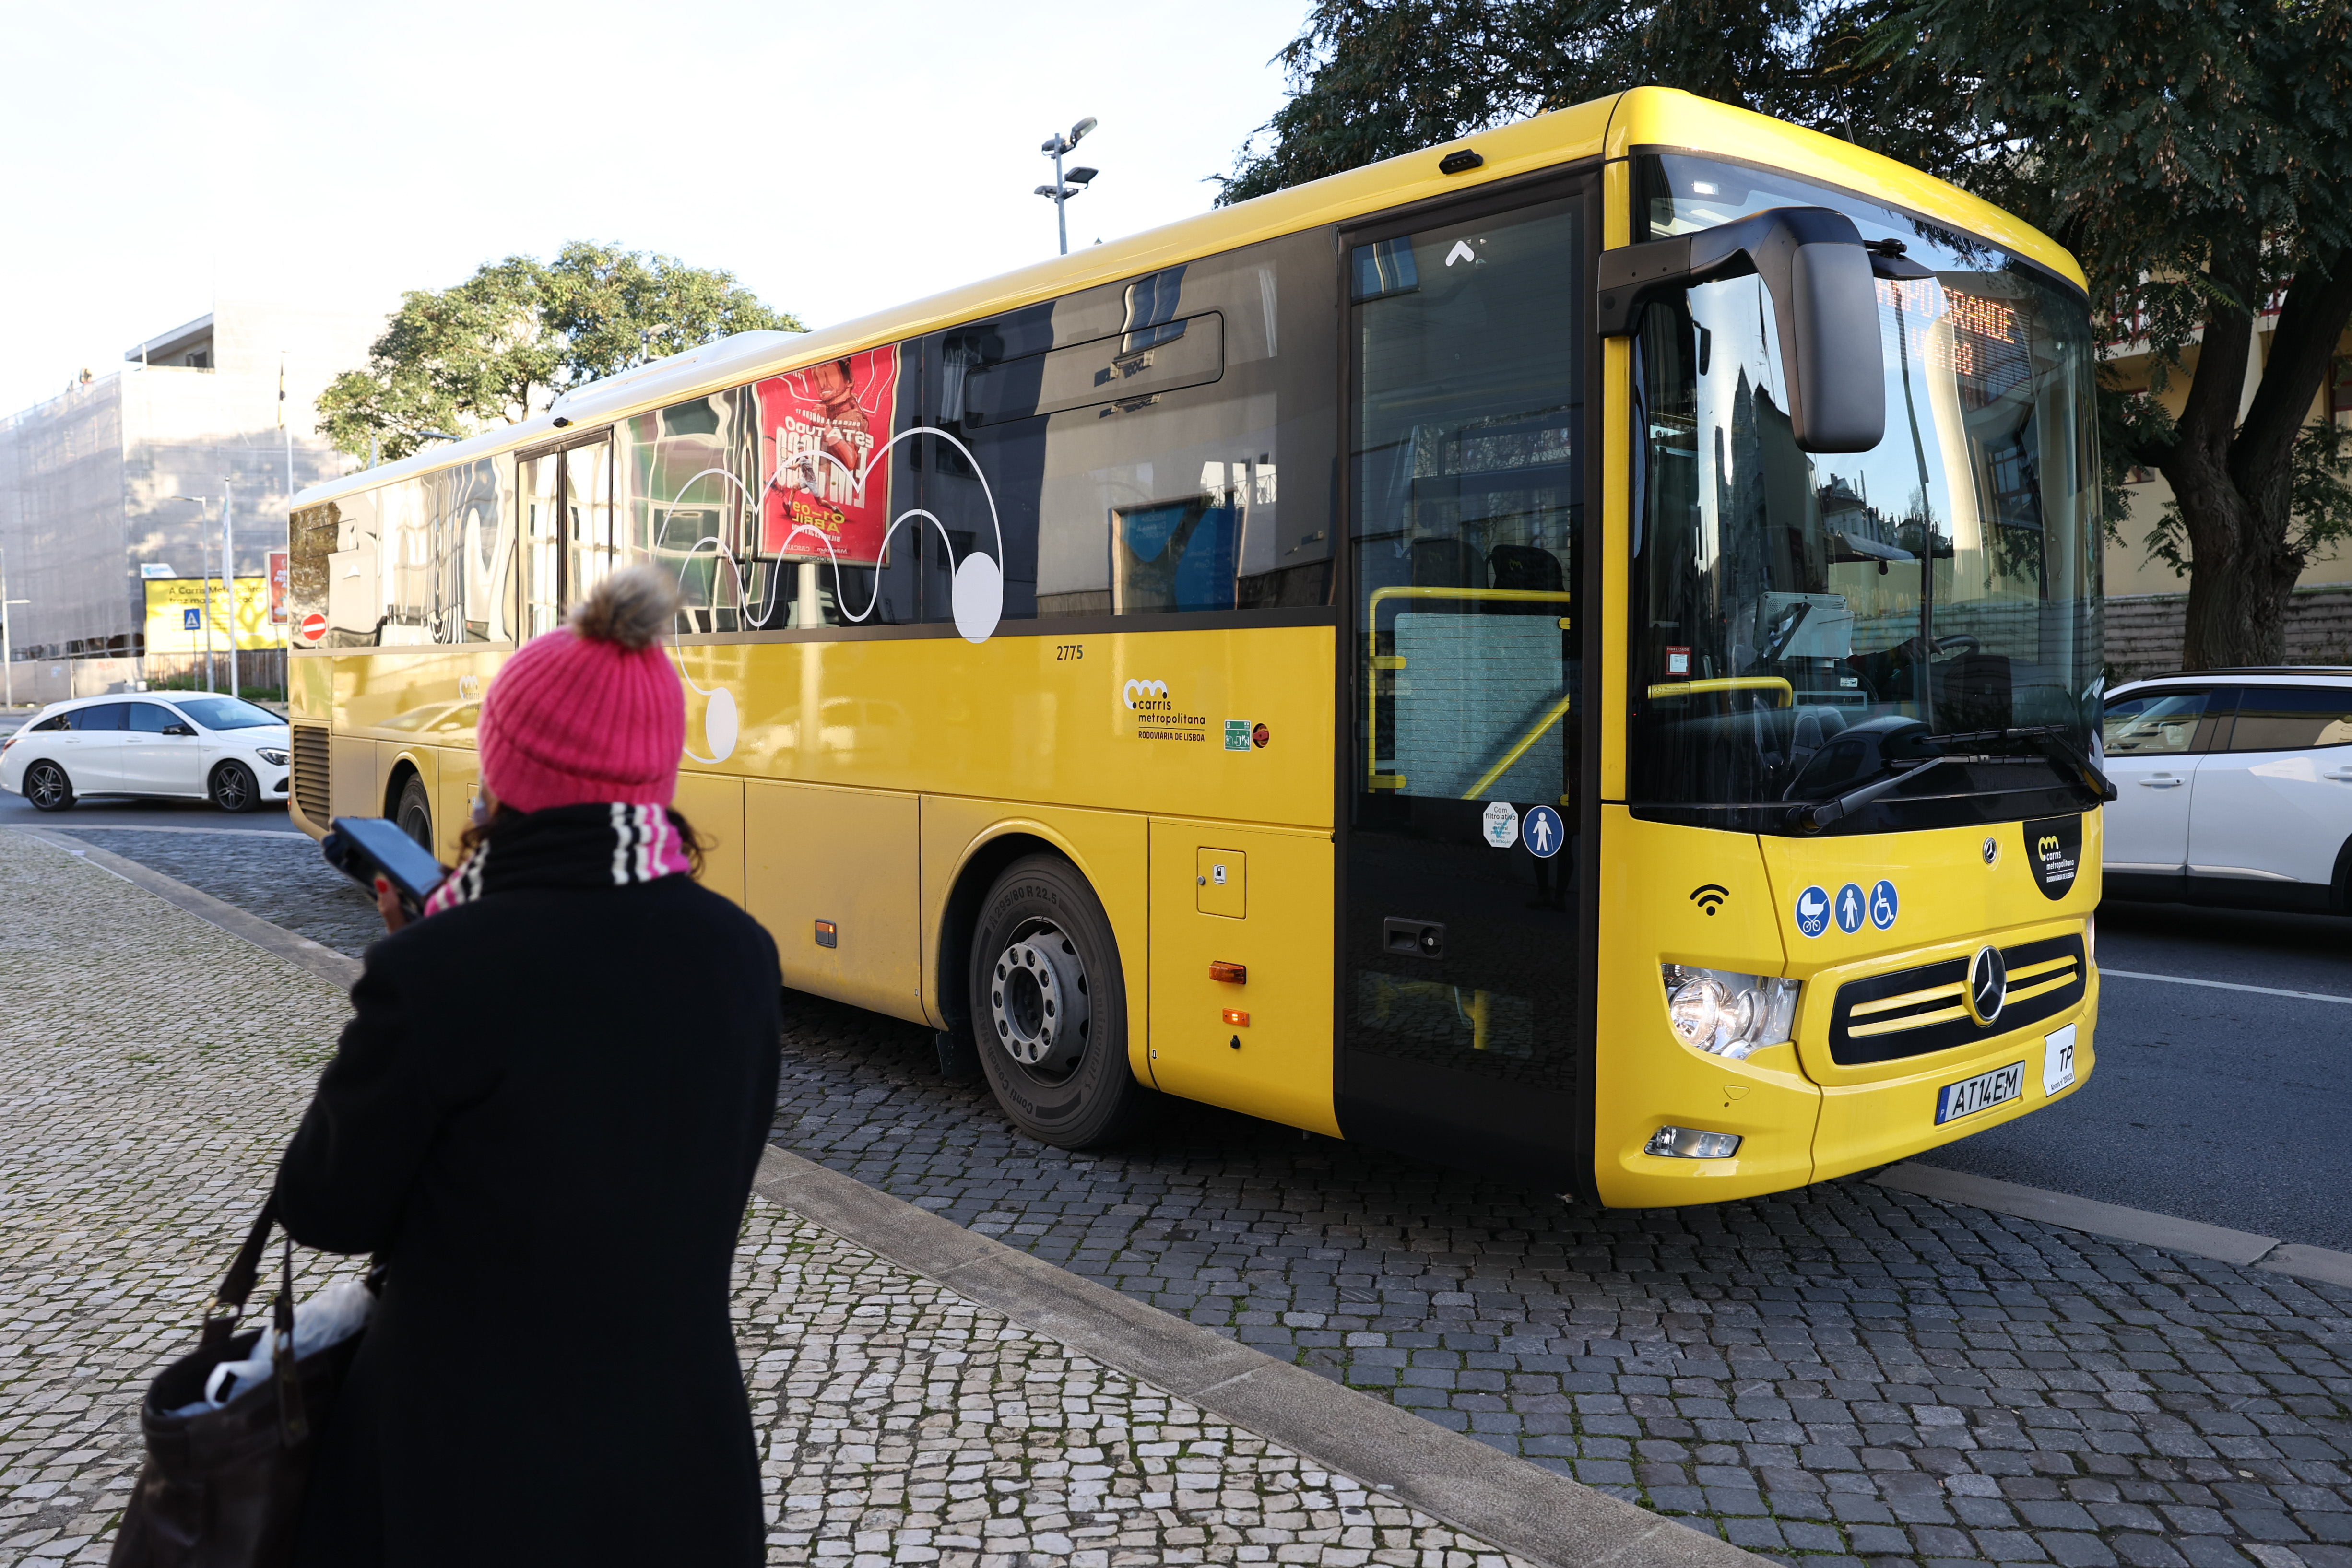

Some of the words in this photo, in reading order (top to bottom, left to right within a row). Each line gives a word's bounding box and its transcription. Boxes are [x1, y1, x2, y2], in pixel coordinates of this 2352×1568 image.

[1940, 285, 2014, 343] GRANDE
[1057, 645, 1083, 660] 2775
[1138, 700, 1171, 711] carris
[1138, 713, 1206, 725] metropolitana
[1138, 731, 1173, 740] RODOVIÁRIA
[1175, 732, 1182, 741] DE
[1183, 733, 1205, 742] LISBOA
[2046, 851, 2061, 861] carris
[2046, 858, 2074, 871] metropolitana
[994, 886, 1025, 917] 295/80
[1026, 885, 1034, 897] R
[1036, 886, 1057, 905] 22.5
[2059, 1045, 2073, 1072] TP
[987, 1046, 1009, 1091] Coach
[1008, 1088, 1033, 1115] Conti
[1940, 1109, 1945, 1117] P
